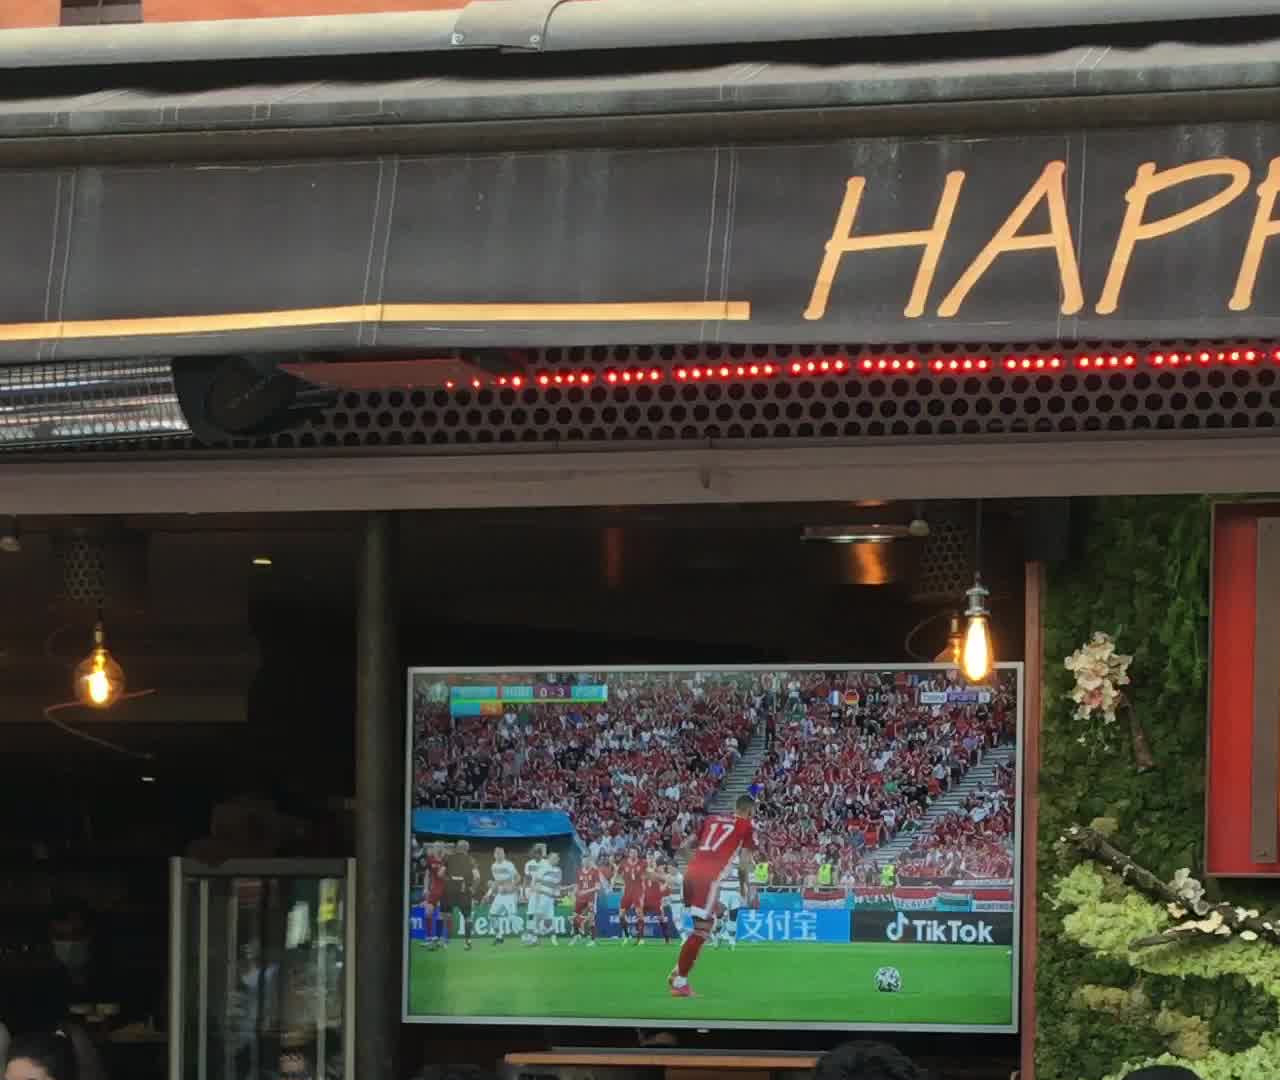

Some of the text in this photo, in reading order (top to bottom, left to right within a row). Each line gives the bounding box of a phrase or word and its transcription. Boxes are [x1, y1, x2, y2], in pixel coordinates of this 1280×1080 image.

[699, 823, 736, 852] 17
[739, 911, 817, 941] 支付宝
[912, 920, 994, 943] TikTok
